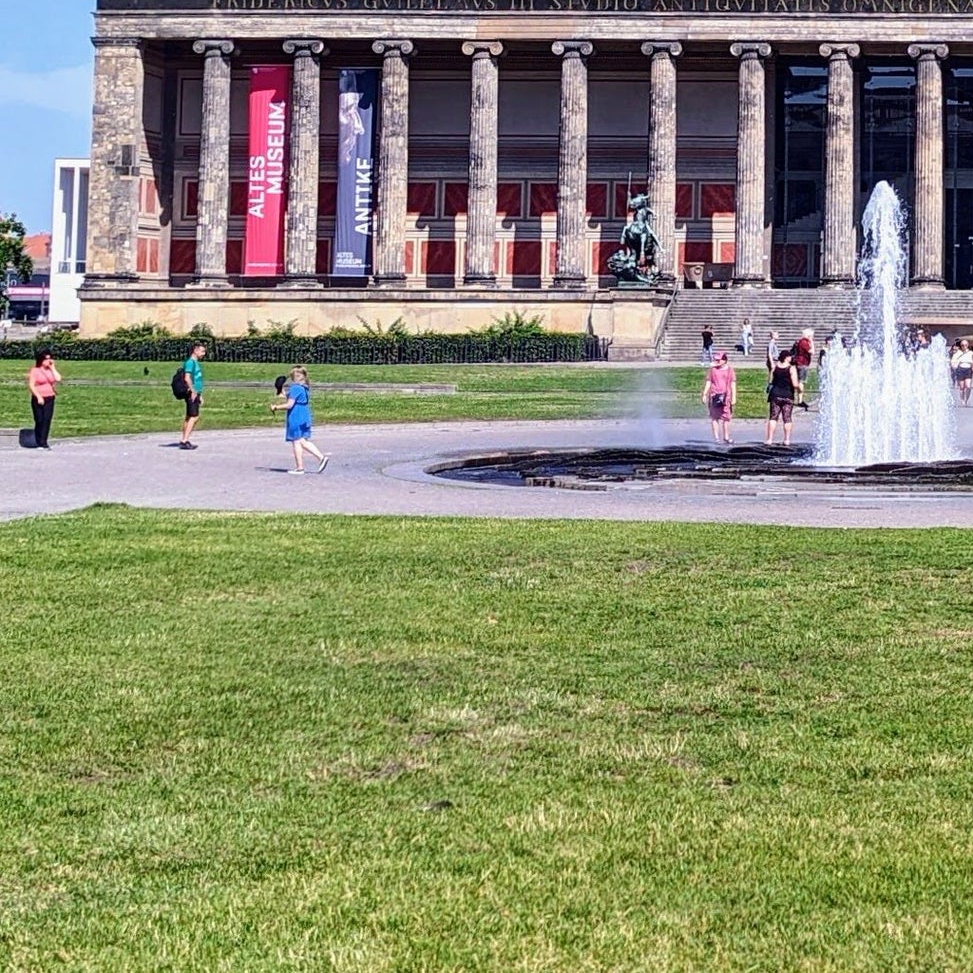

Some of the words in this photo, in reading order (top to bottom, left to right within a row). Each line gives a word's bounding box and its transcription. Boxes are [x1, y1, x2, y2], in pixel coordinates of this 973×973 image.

[266, 100, 286, 195] MUSEUM
[248, 155, 265, 219] ALTES
[354, 158, 374, 236] ANTIKE
